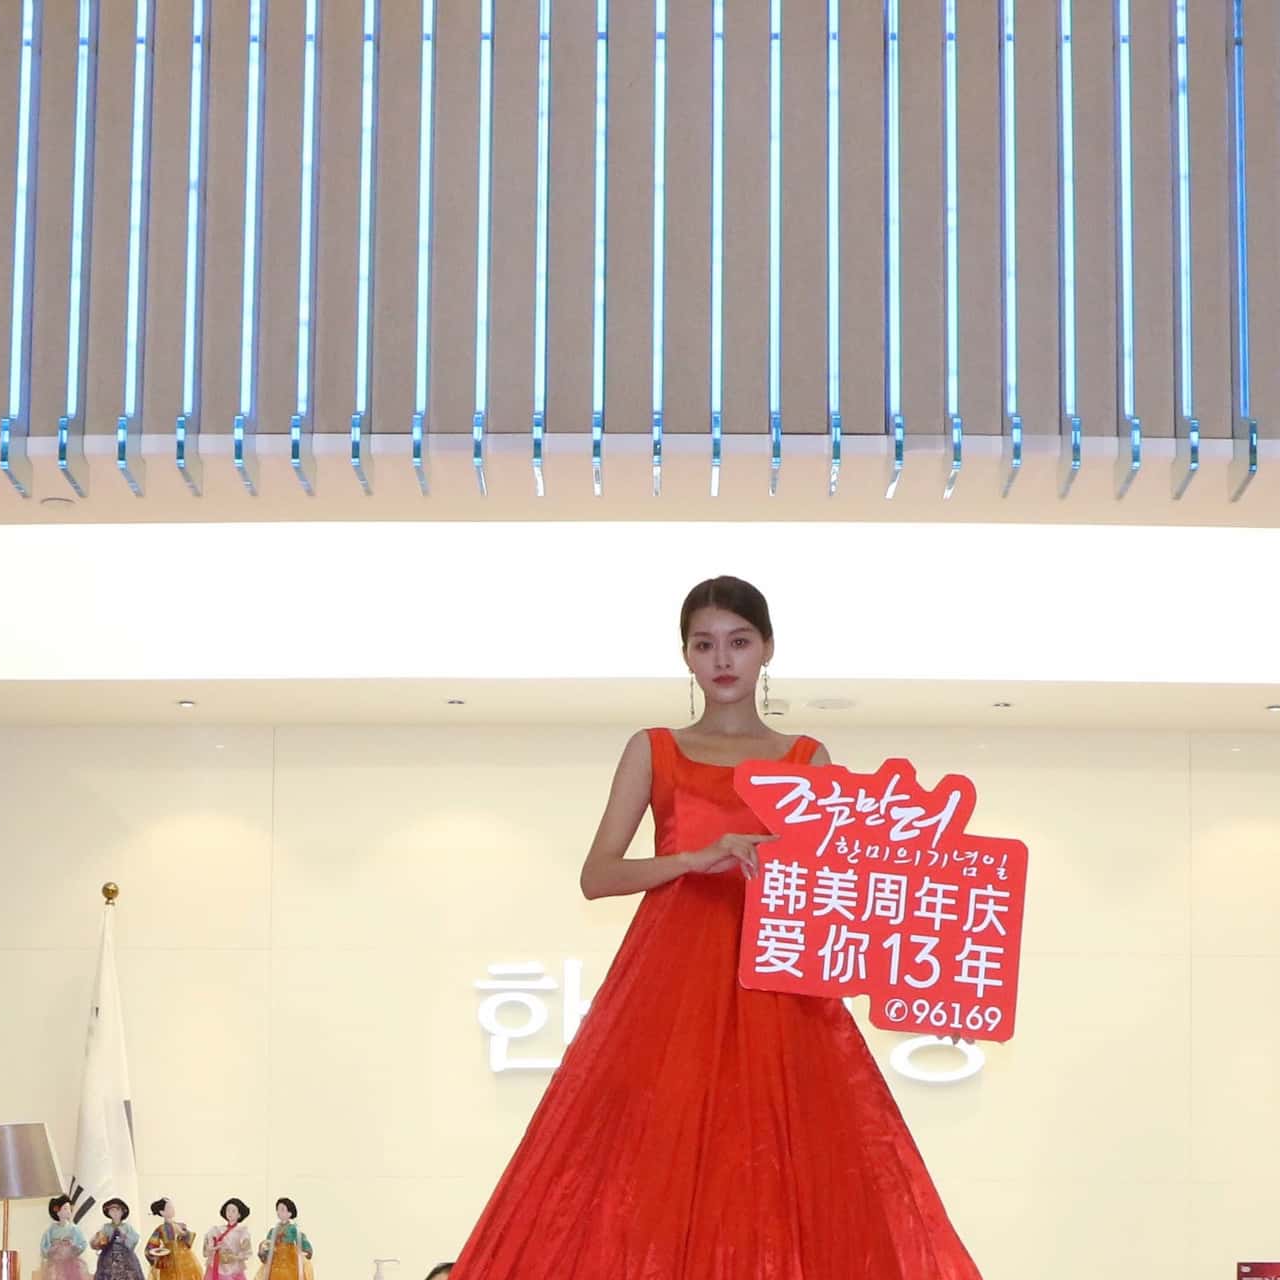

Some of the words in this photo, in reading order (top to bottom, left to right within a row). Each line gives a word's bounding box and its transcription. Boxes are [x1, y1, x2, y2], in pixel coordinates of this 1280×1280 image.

[760, 858, 1011, 937] 韩美周年庆
[753, 916, 1005, 998] 爱你13年
[911, 999, 1003, 1032] 96169
